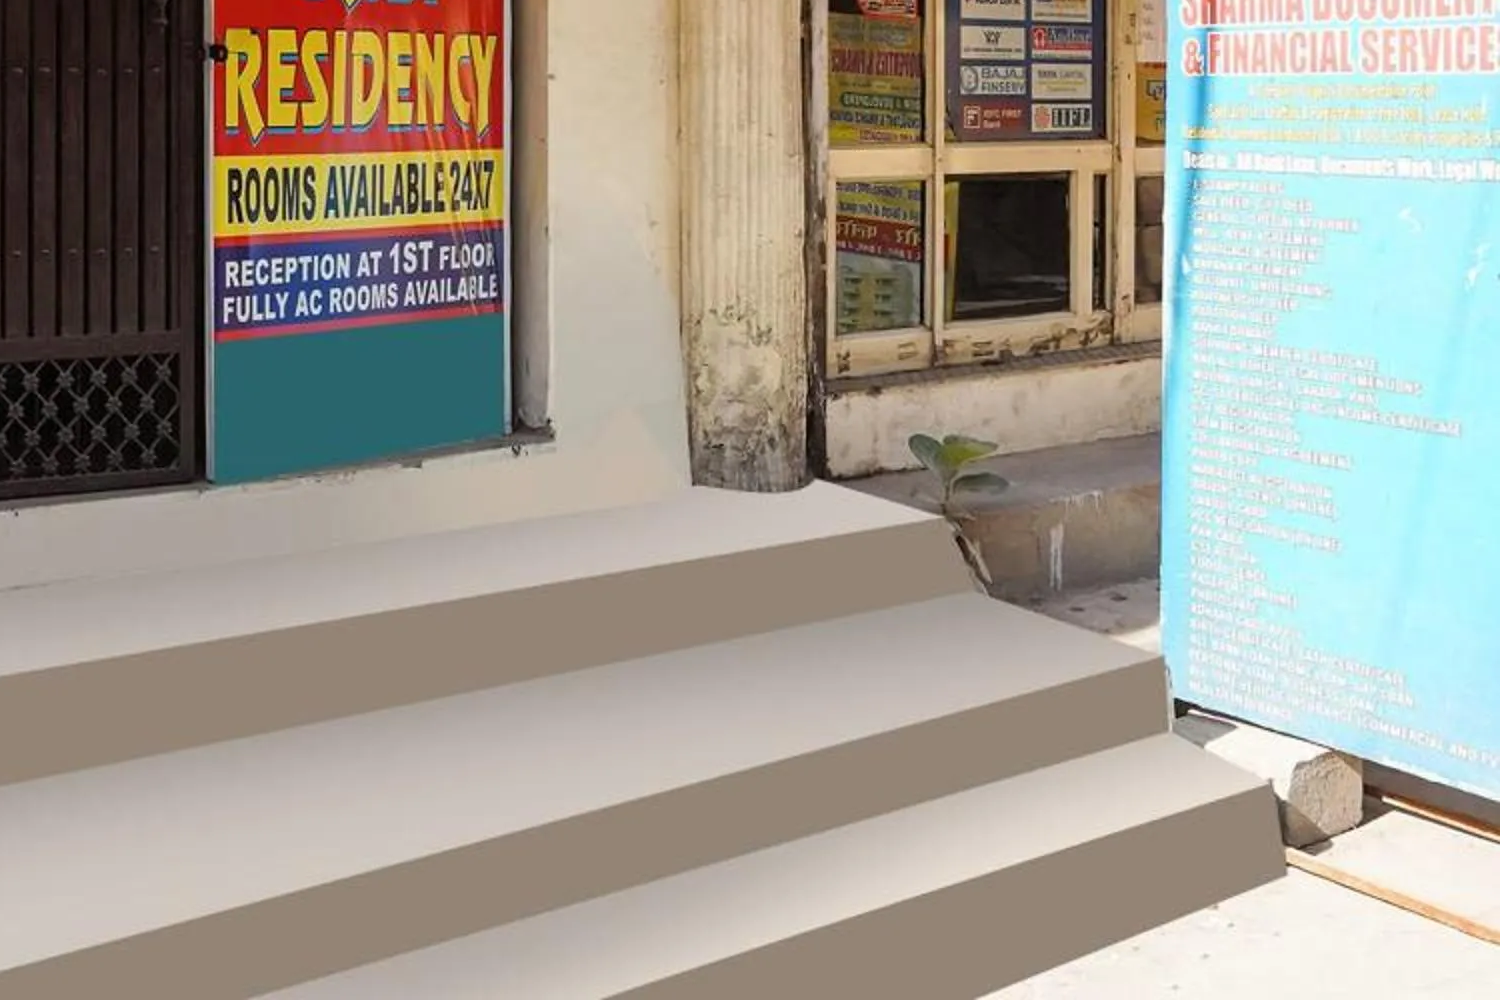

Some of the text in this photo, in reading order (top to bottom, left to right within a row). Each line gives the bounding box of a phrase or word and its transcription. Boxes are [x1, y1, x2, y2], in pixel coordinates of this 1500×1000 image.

[981, 67, 1025, 79] BAJAJ
[1183, 22, 1500, 76] & FINANCIAL SERVICE
[225, 27, 497, 146] RESIDENCY
[981, 80, 1025, 93] FINSERV
[227, 160, 494, 224] ROOMS AVAILABLE 24X7
[1480, 160, 1500, 182] Wo
[225, 240, 495, 289] RECEPTION AT 1ST FLOOR
[223, 274, 498, 324] FULLY AC ROOMS AVAILABLE
